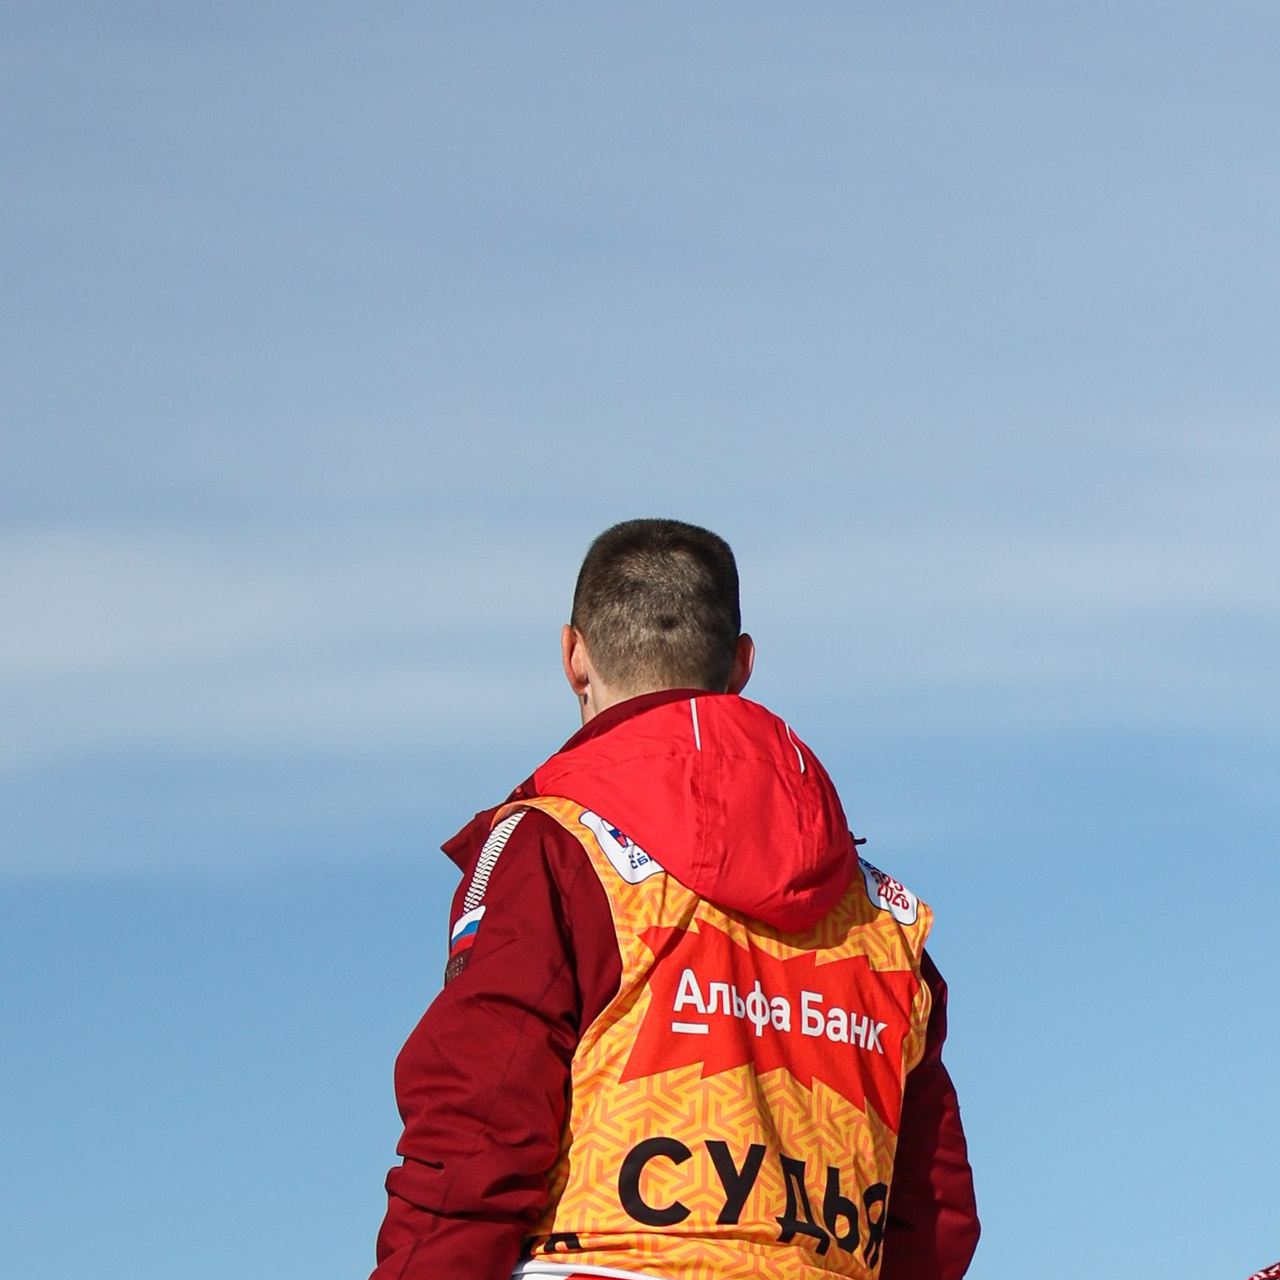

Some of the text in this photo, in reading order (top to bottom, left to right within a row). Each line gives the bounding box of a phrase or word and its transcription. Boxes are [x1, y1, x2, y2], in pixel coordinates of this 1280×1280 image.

[630, 855, 652, 869] СБ
[671, 968, 888, 1055] Альфа Банк
[618, 1137, 888, 1270] СУДЬЯ
